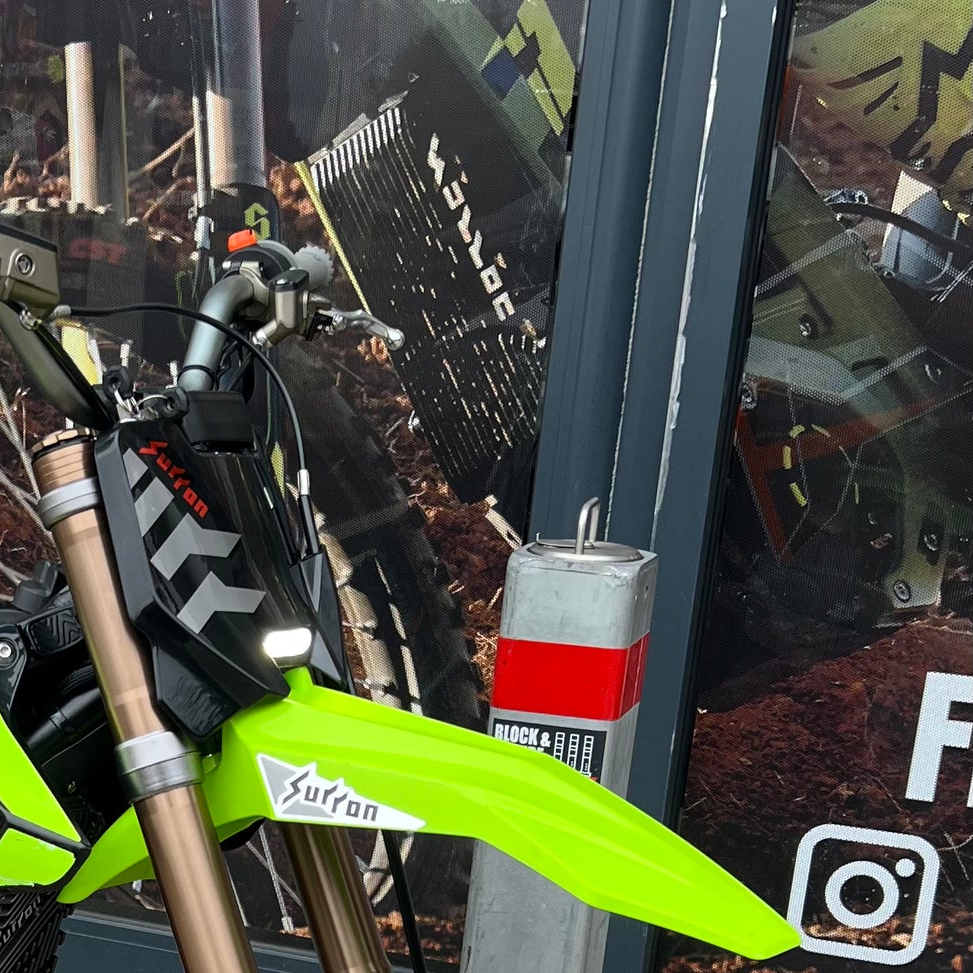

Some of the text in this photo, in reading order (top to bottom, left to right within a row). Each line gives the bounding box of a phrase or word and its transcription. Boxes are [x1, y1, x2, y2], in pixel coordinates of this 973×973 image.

[139, 440, 209, 519] Surron
[494, 723, 551, 748] BLOCK &
[282, 769, 379, 822] Surron
